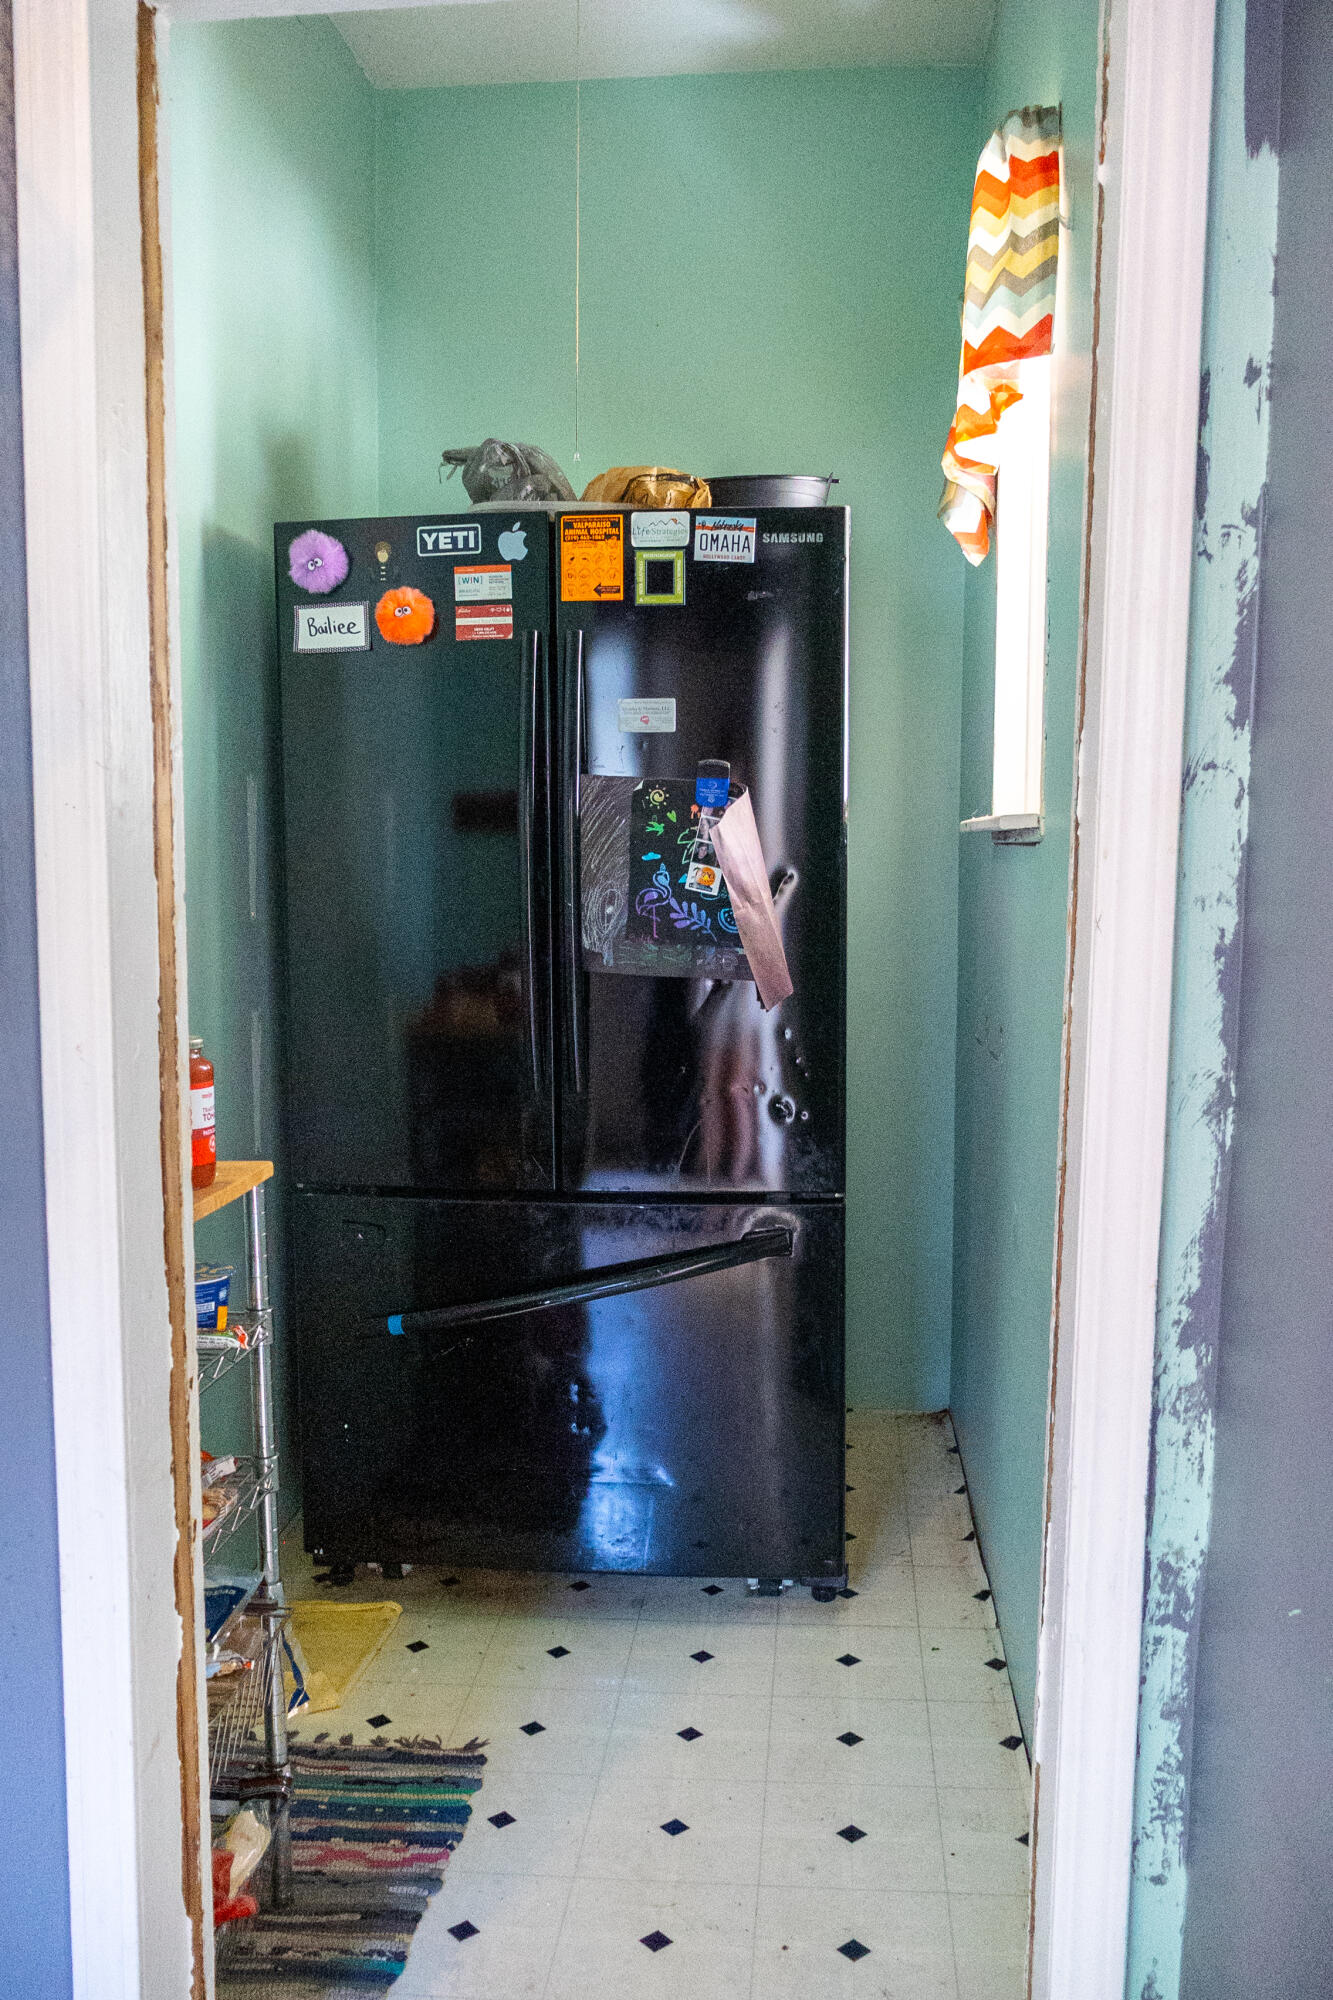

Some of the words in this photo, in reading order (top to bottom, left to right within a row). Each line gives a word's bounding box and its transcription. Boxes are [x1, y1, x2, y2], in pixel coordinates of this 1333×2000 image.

[573, 521, 611, 529] VALPARAISO
[632, 525, 649, 536] Life
[564, 528, 588, 536] ANIMAL
[590, 527, 620, 535] HOSPITAL
[421, 530, 475, 550] YETI
[699, 533, 751, 553] OMAHA
[762, 532, 824, 543] SAMSUNG
[306, 615, 361, 637] Bailiee
